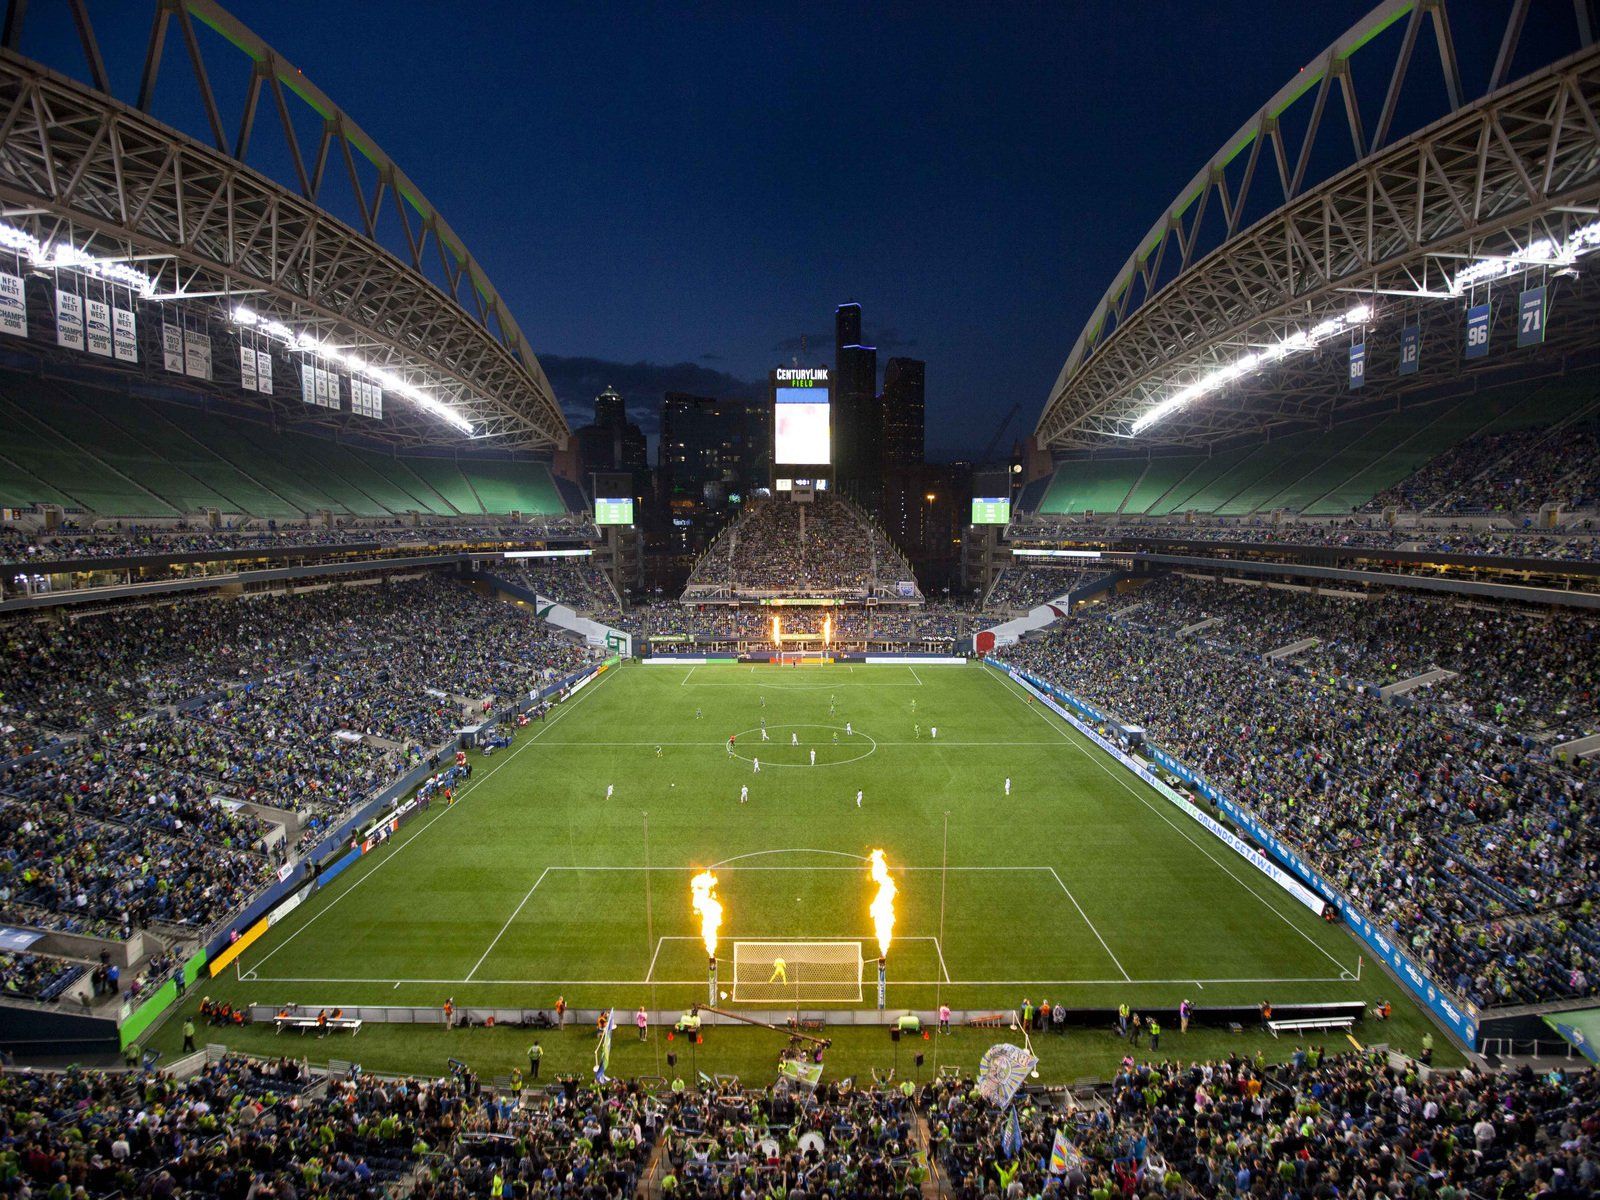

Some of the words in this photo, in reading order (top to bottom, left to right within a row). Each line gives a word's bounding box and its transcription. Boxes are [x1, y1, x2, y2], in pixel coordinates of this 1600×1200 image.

[2, 276, 17, 288] NFC
[1, 284, 20, 296] WEST
[63, 294, 76, 304] NFC
[61, 302, 78, 312] WEST
[91, 303, 104, 313] NFC
[90, 311, 106, 320] WEST
[118, 312, 130, 321] NFC
[1522, 309, 1541, 333] 71
[4, 319, 22, 329] 2006
[117, 319, 132, 328] WEST
[59, 325, 83, 337] CHAMPS
[1468, 324, 1488, 346] 96
[64, 333, 79, 343] 2007
[88, 333, 111, 344] CHAMPS
[166, 334, 180, 345] 2013
[93, 340, 107, 350] 2010
[114, 340, 136, 351] CHAMPS
[1402, 344, 1416, 364] 12
[1350, 361, 1364, 378] 80
[791, 380, 814, 388] FIELD
[1155, 781, 1188, 812] SOUNDERS
[1188, 806, 1198, 817] FC
[1198, 813, 1234, 846] ORLANDO
[1234, 841, 1283, 883] GETAWAY!
